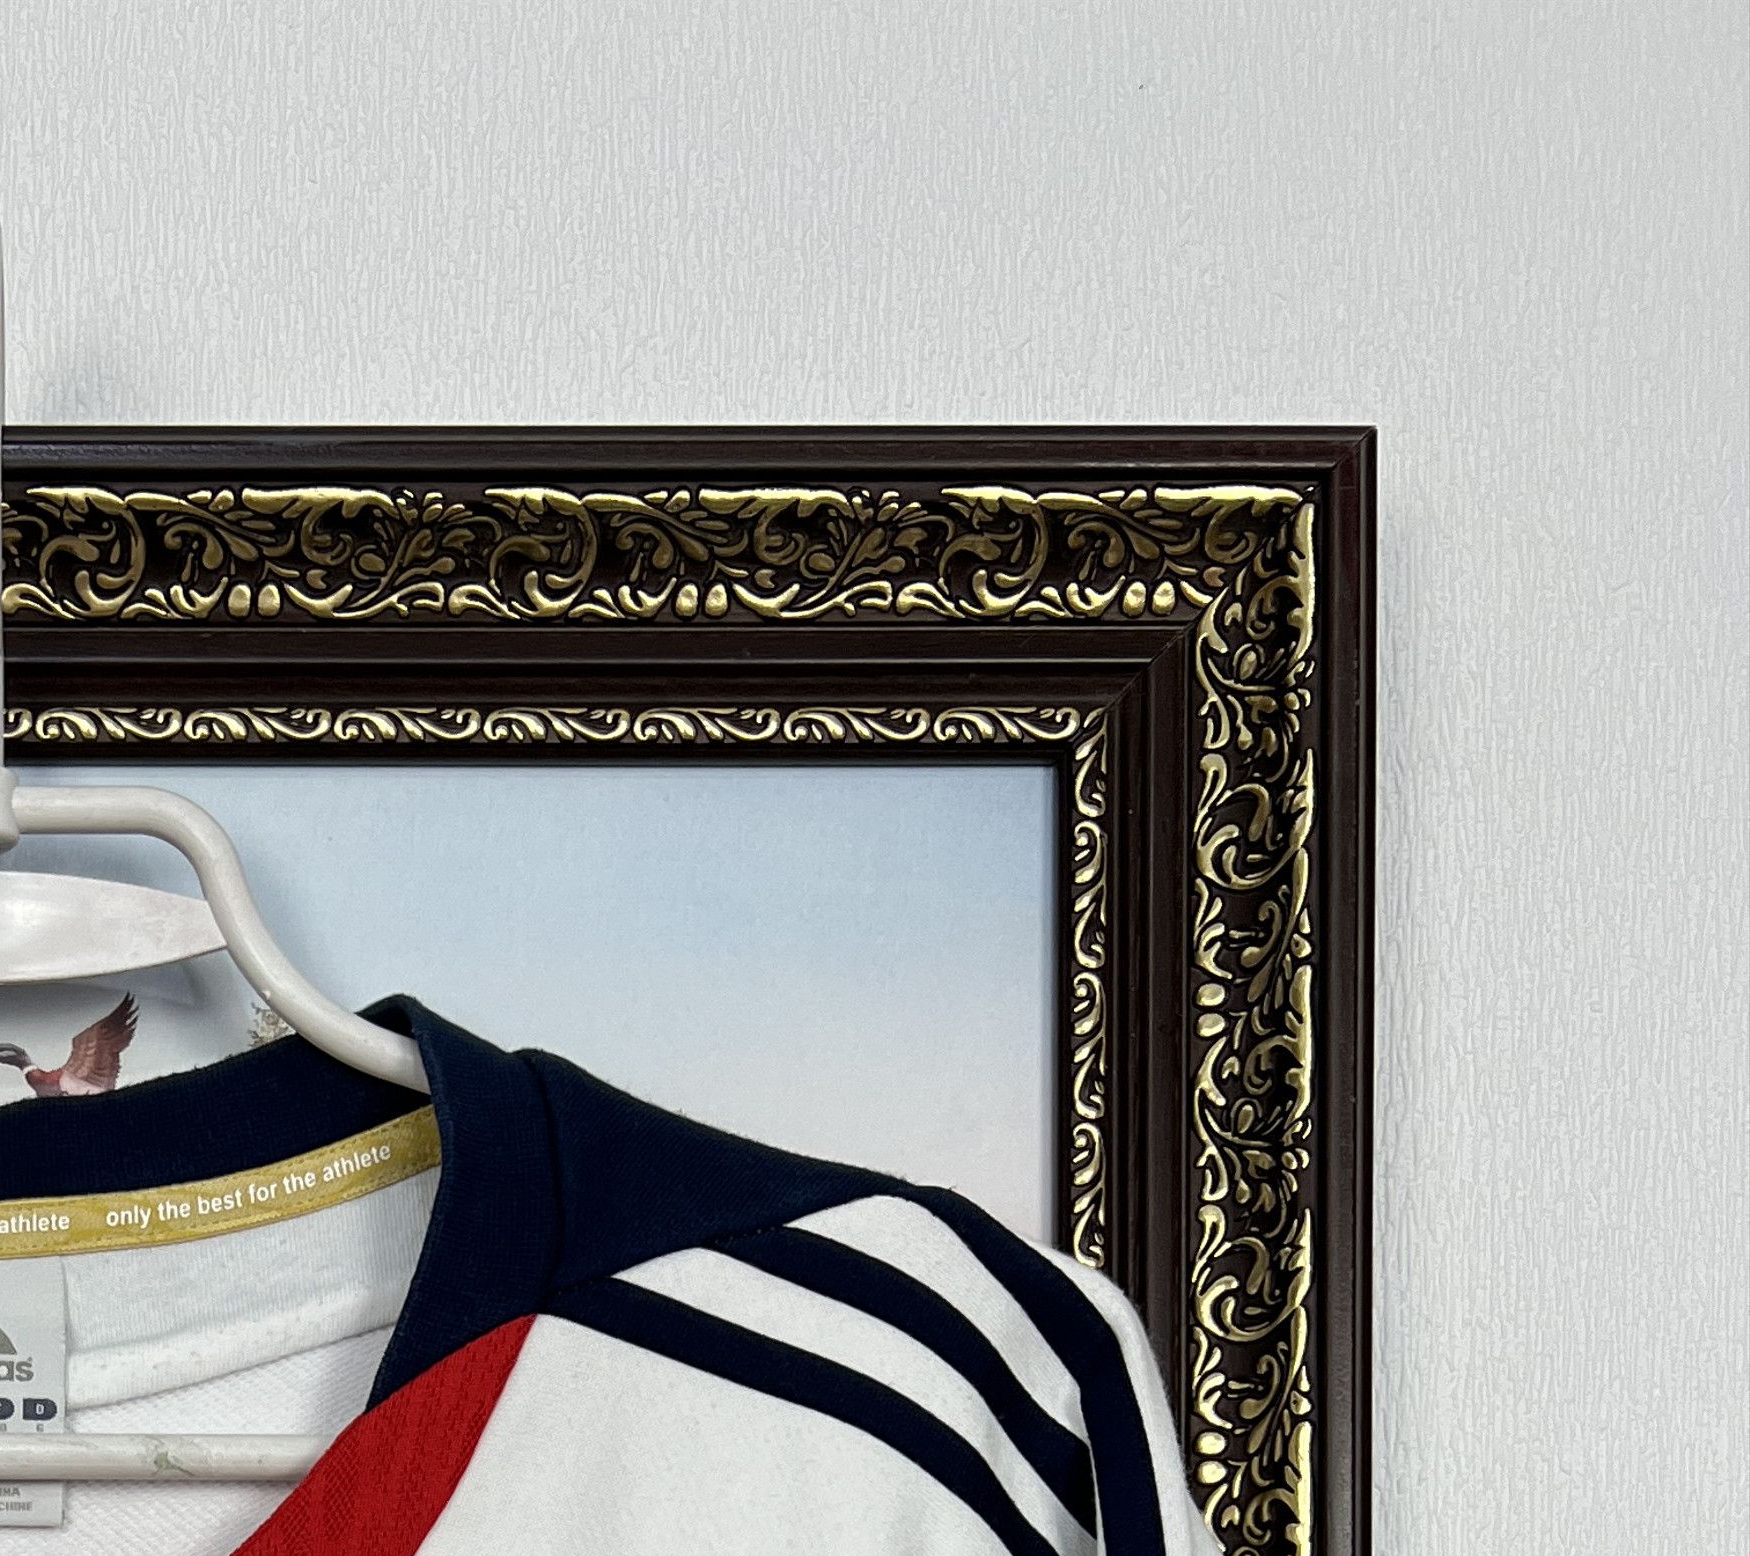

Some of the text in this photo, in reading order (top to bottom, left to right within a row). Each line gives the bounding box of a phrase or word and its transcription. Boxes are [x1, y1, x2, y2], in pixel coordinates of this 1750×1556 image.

[106, 1142, 392, 1230] only the best for the athlete
[35, 1403, 45, 1415] D
